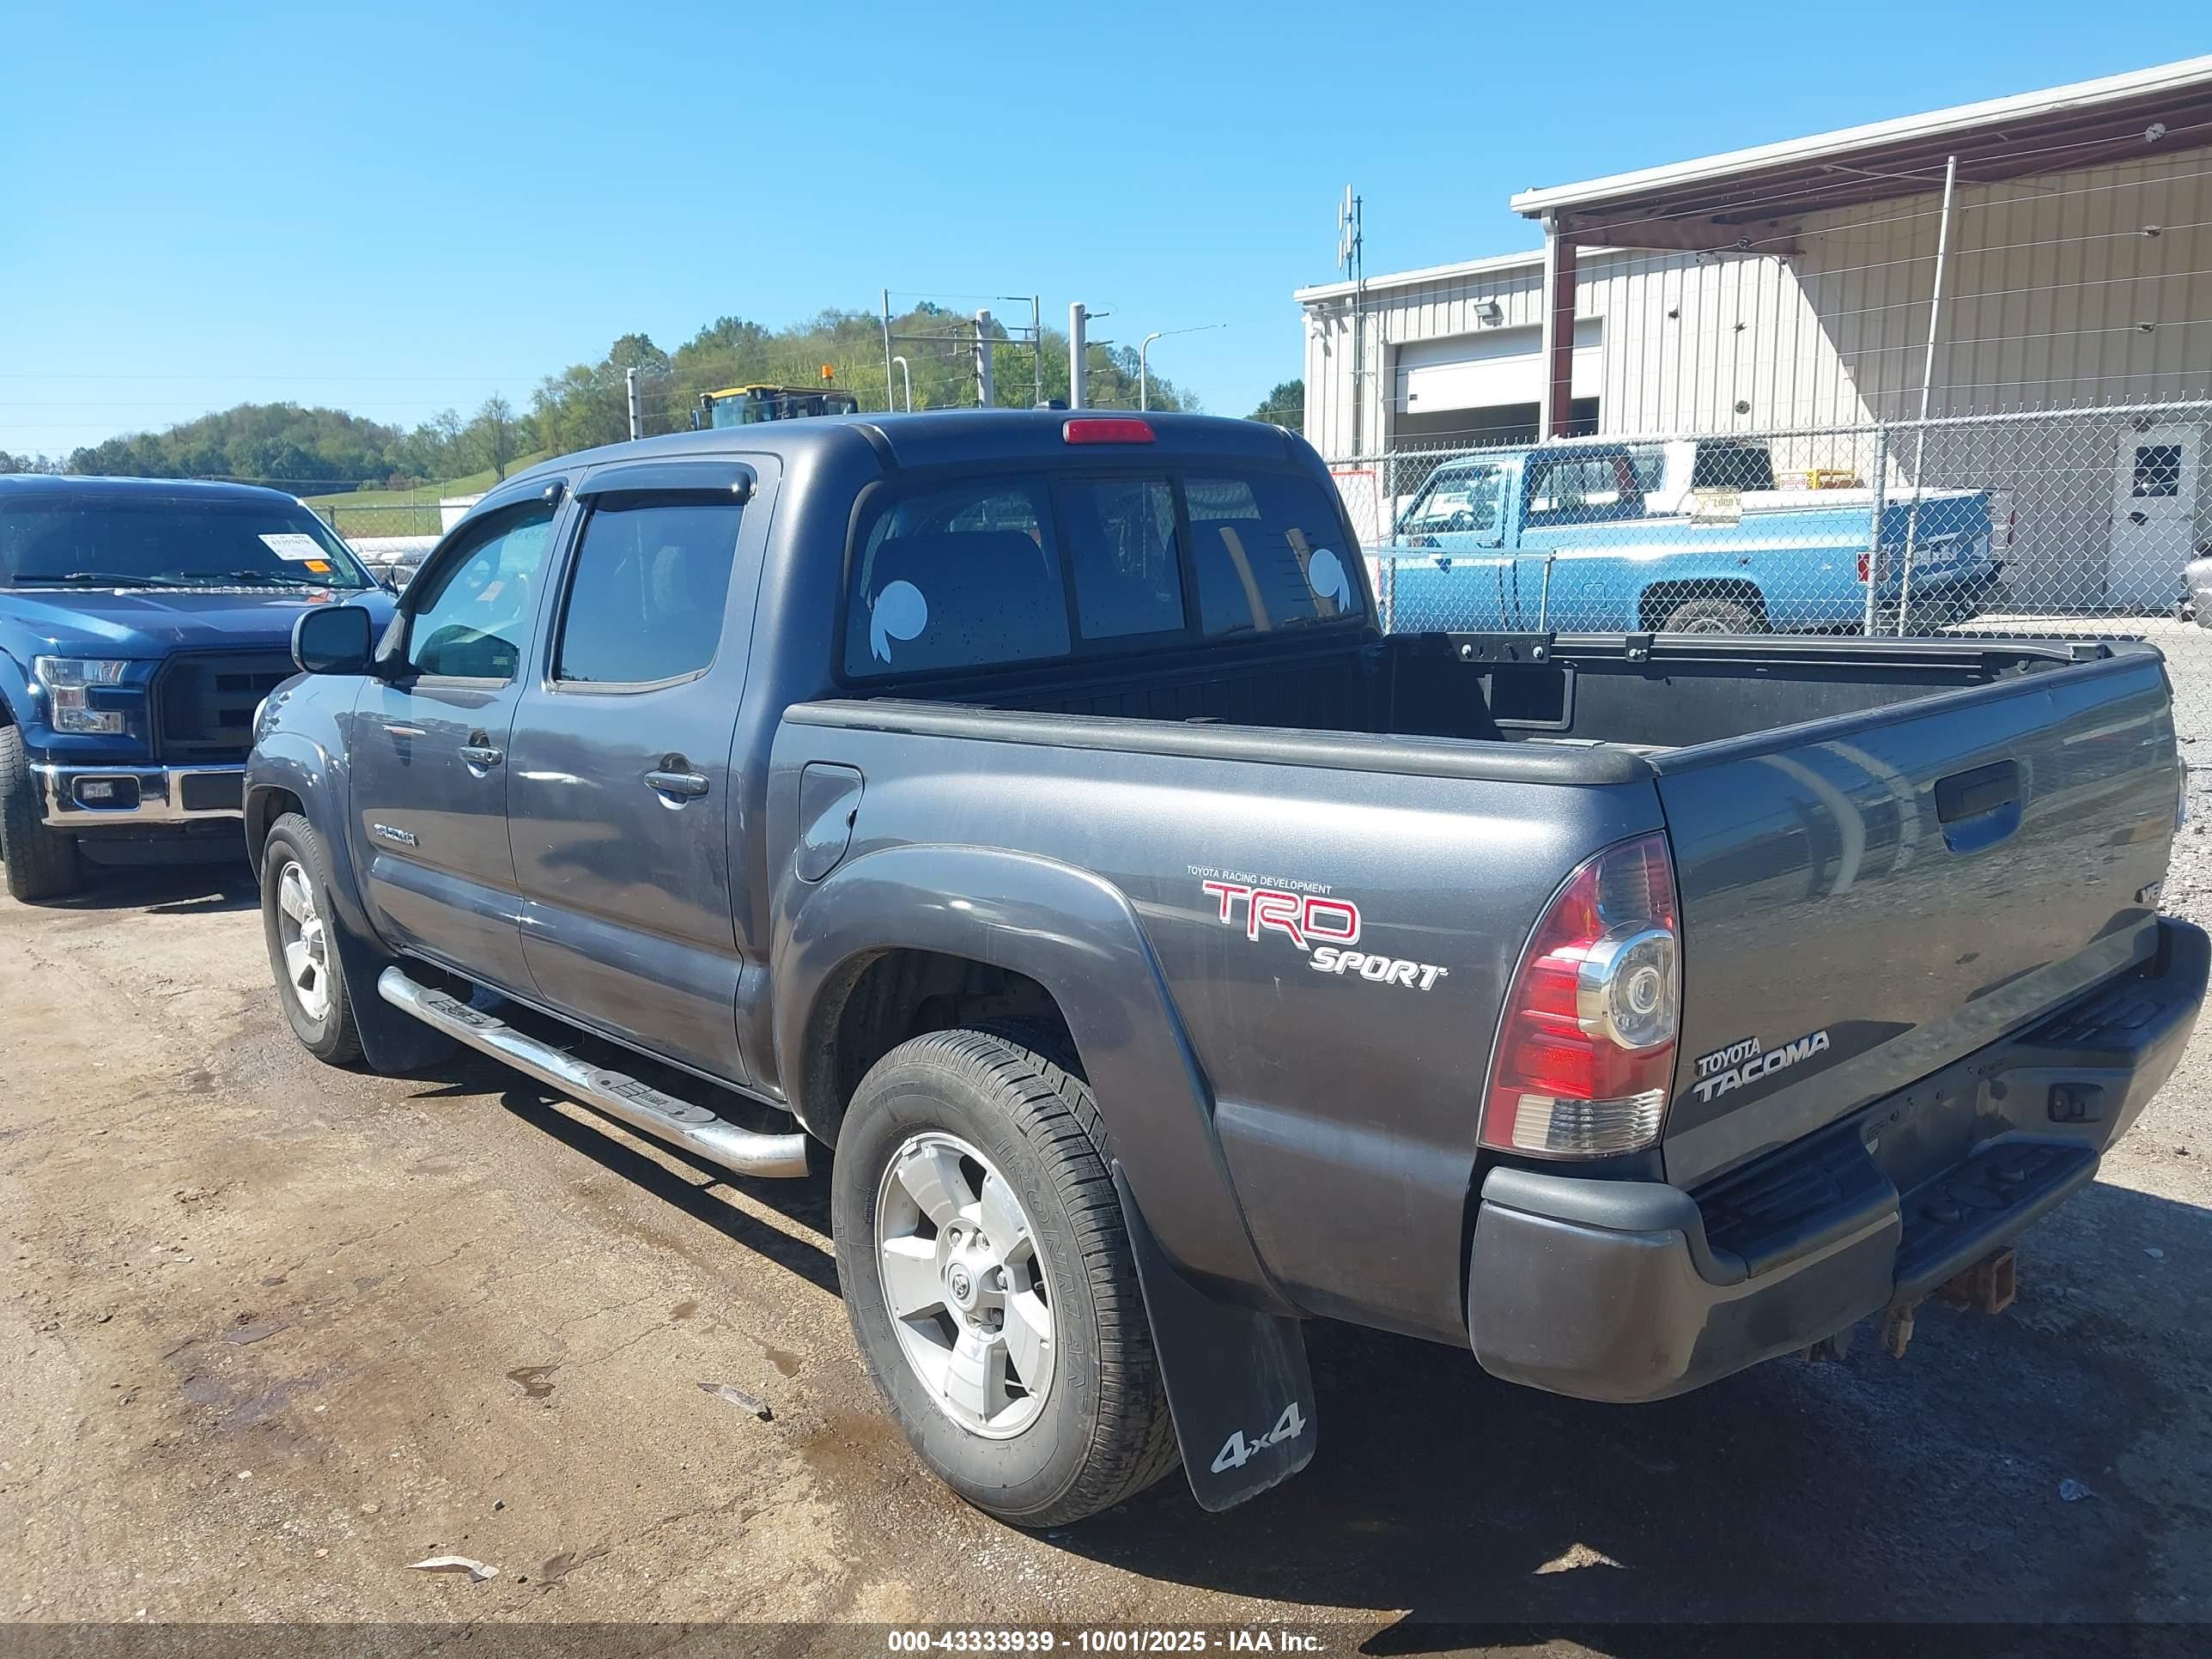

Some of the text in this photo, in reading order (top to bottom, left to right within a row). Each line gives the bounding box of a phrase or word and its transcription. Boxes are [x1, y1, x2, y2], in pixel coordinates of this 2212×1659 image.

[1187, 865, 1333, 896] TOYOTA RACING DEVELOPMENT
[1202, 879, 1362, 951] TRD
[1309, 946, 1449, 992] SPORT
[1692, 1030, 1831, 1103] TACOMA
[1698, 1036, 1761, 1078] TOYOTA
[1210, 1401, 1307, 1474] 4x4
